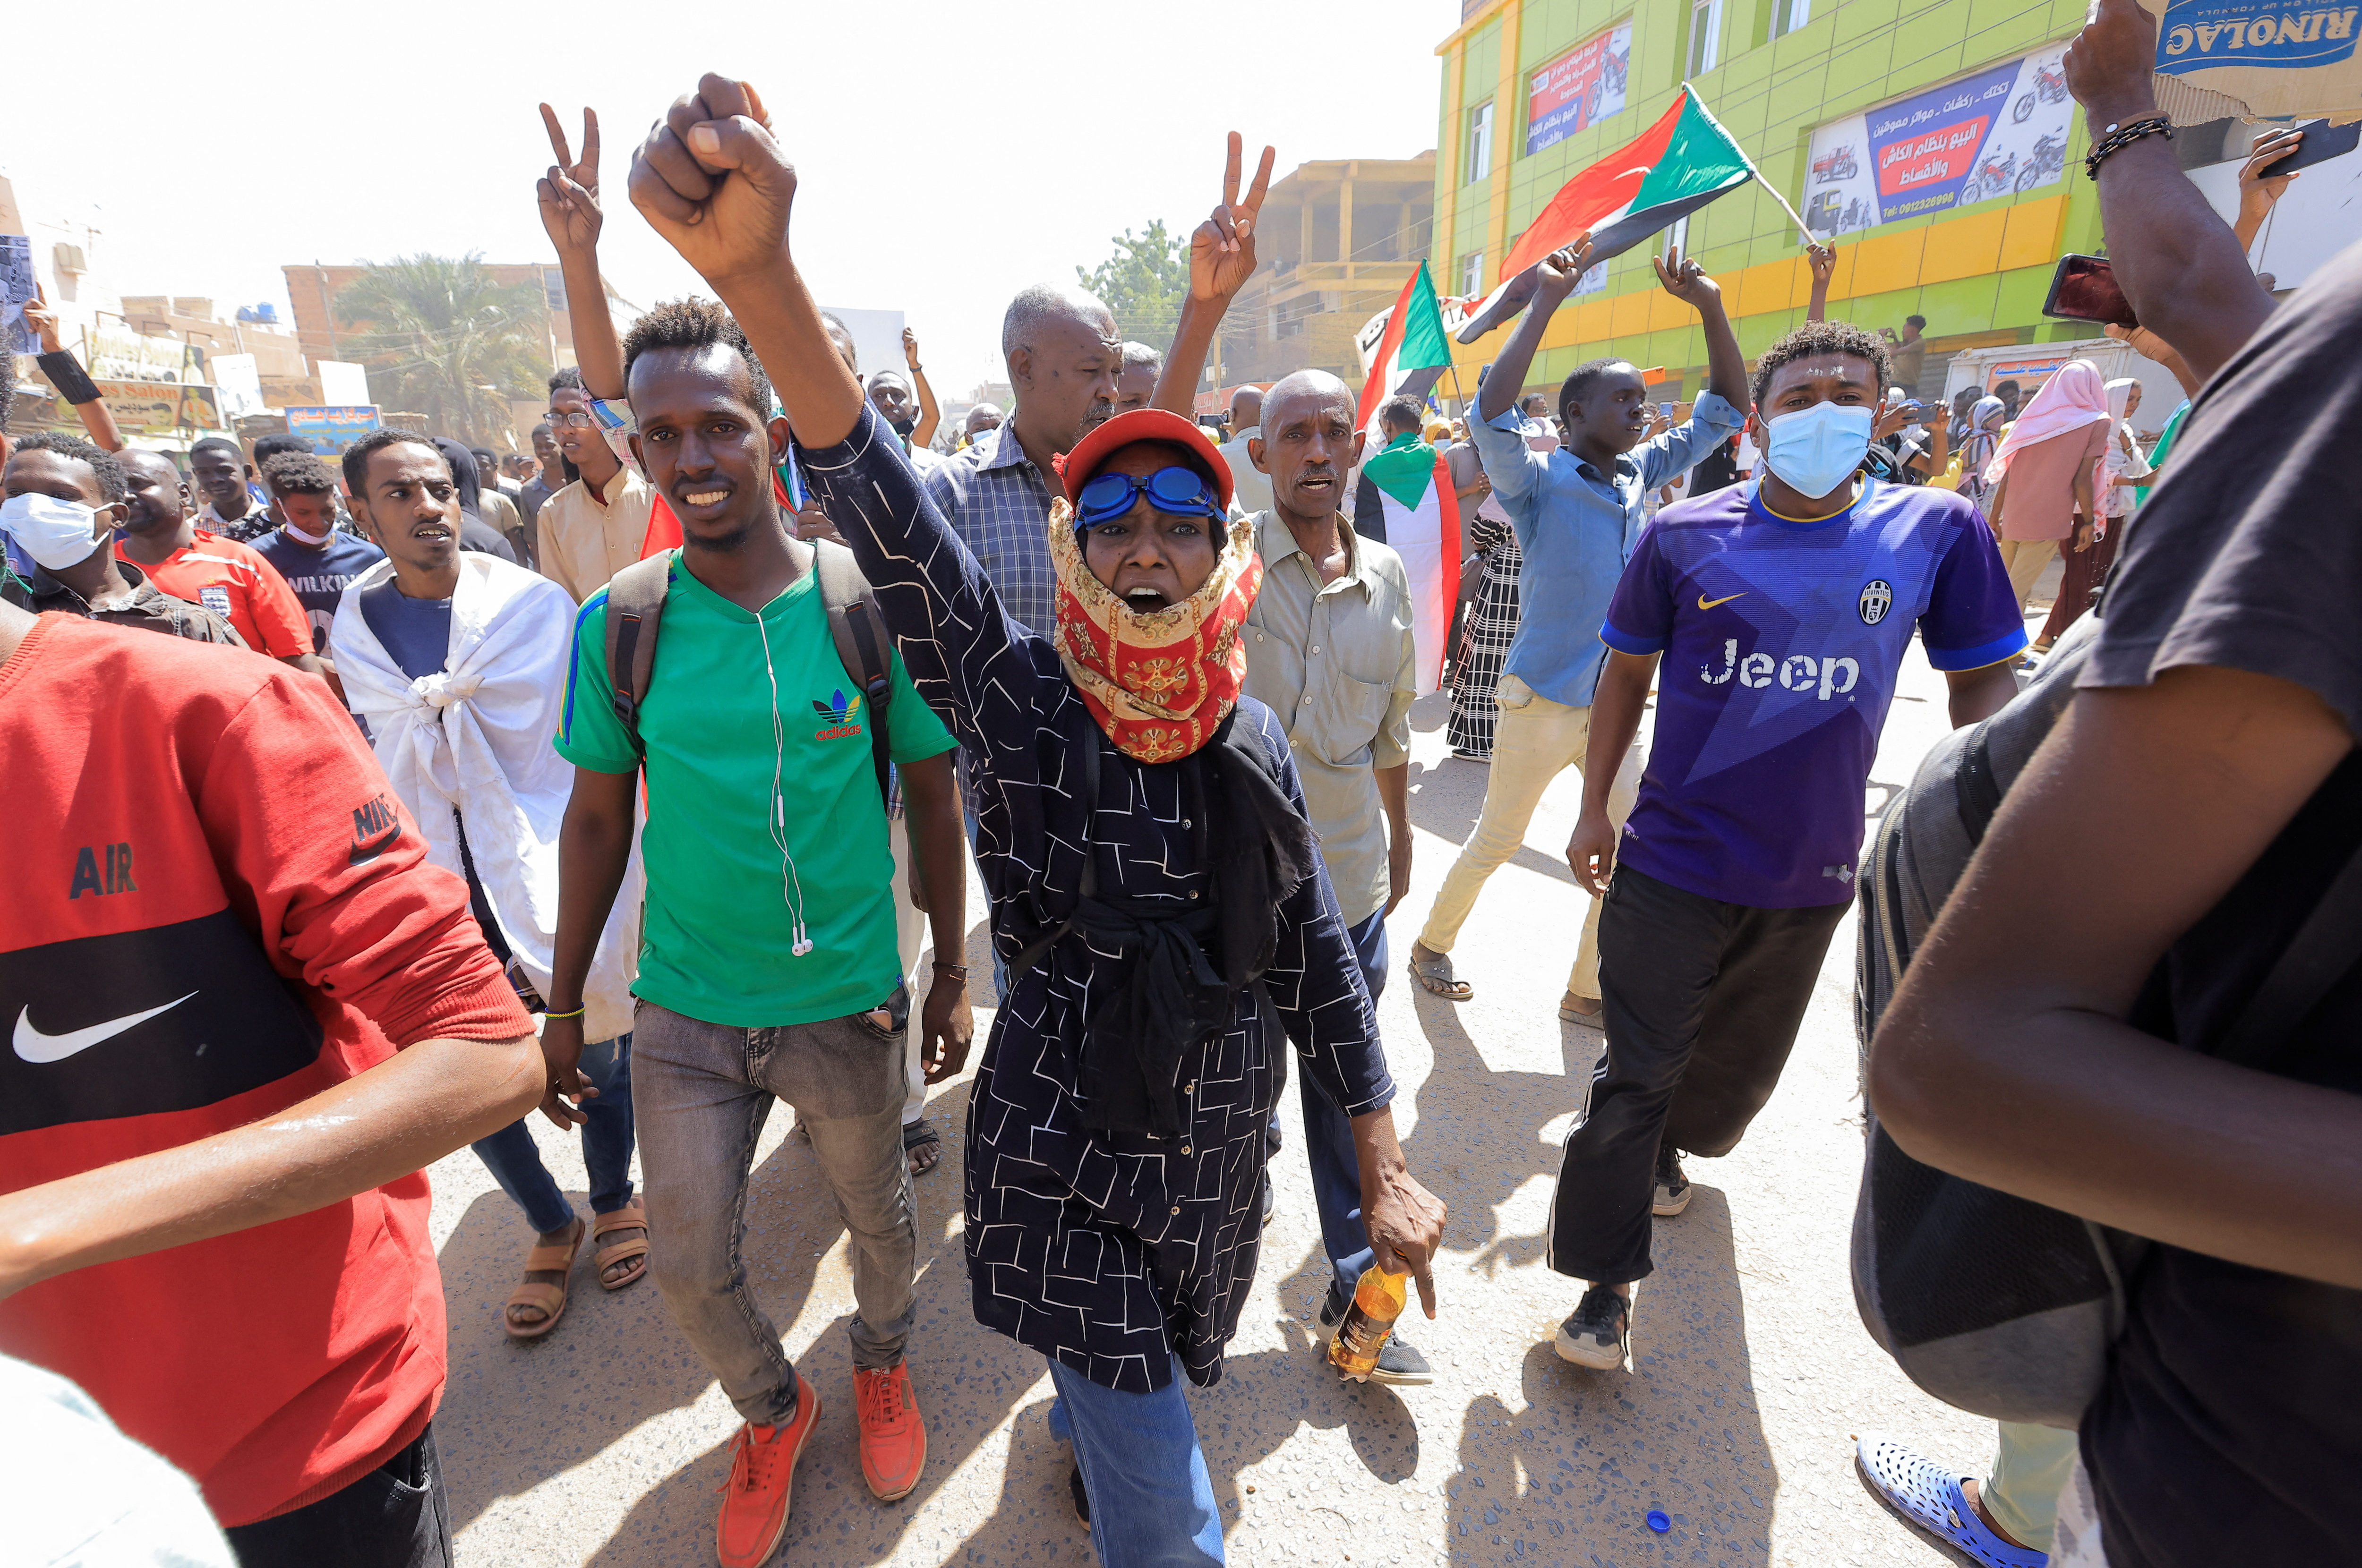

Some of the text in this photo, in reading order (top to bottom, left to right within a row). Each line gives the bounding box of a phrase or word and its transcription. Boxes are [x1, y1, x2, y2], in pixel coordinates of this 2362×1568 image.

[2198, 6, 2255, 16] FORMULA
[2165, 8, 2358, 55] RINOLAC
[1882, 122, 1979, 170] البيع بنظام الكاش
[1899, 158, 1949, 187] والأقساط
[124, 383, 179, 400] Salon
[1865, 589, 1889, 597] JUVENTUS
[1701, 639, 1859, 700] Jeep
[815, 724, 861, 741] adidas
[69, 842, 138, 900] AIR
